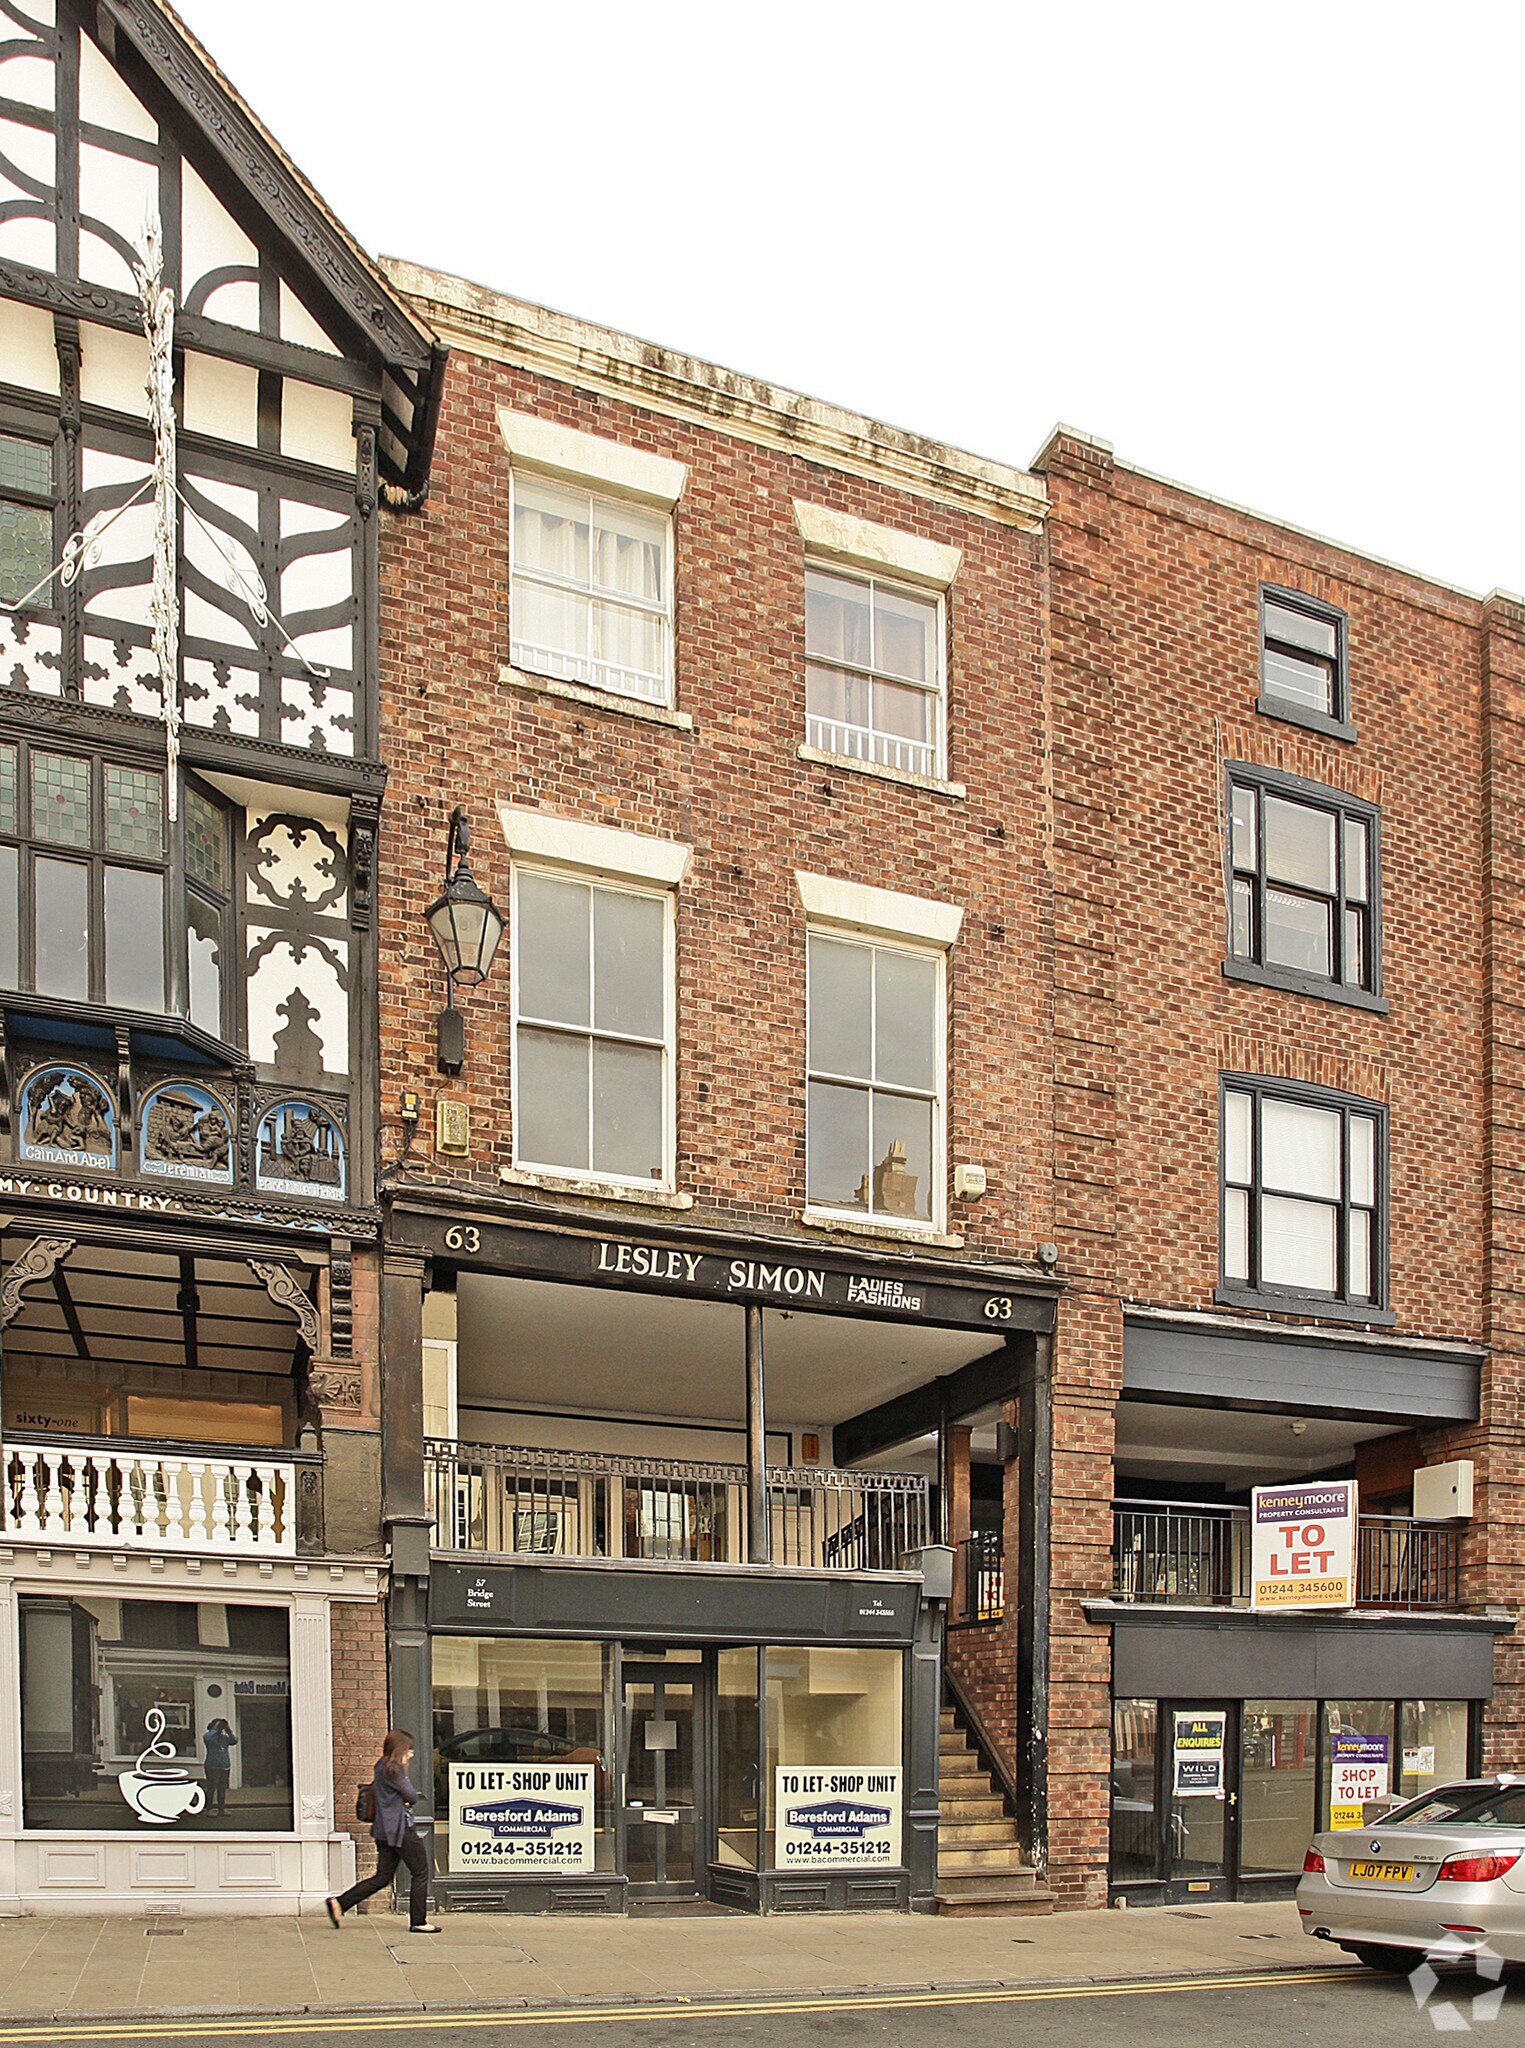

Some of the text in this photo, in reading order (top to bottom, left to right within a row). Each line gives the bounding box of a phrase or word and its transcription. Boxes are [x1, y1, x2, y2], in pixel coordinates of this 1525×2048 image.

[25, 1146, 111, 1170] Cain And Abel
[48, 1184, 172, 1211] COUNTRY
[445, 1226, 481, 1253] 63
[598, 1243, 826, 1298] LESLEY SIMON
[849, 1276, 904, 1295] LADIES
[847, 1289, 921, 1311] FASHIONS
[984, 1296, 1013, 1320] 63
[16, 1412, 79, 1428] sixty-one
[1259, 1492, 1345, 1508] kenneymoore
[1259, 1507, 1344, 1518] PROPERTY CONSULTANTS
[1279, 1524, 1325, 1548] TO
[1270, 1551, 1335, 1575] LET
[475, 1579, 486, 1587] 57
[1260, 1582, 1343, 1594] 01244 345600
[467, 1588, 494, 1599] Bridge
[467, 1598, 491, 1608] Street
[1192, 1722, 1208, 1733] ALL
[1177, 1737, 1222, 1748] ENQUIRIES
[1337, 1741, 1384, 1753] kenneymoore
[456, 1771, 475, 1790] TO
[555, 1773, 588, 1790] UNIT
[1342, 1769, 1376, 1781] SHOP
[782, 1776, 798, 1793] TO
[867, 1776, 897, 1792] UNIT
[1338, 1786, 1379, 1799] TO LET
[465, 1808, 579, 1822] Beresford Adams
[789, 1811, 887, 1823] Beresford Adams
[498, 1825, 547, 1833] COMMERCIAL
[461, 1841, 583, 1855] 01244-351212
[786, 1841, 891, 1854] 01244-351212
[462, 1856, 582, 1865] www.bacommercial.com
[786, 1855, 890, 1864] www.bacommercial.com
[1353, 1865, 1408, 1879] LJ07 FPV
